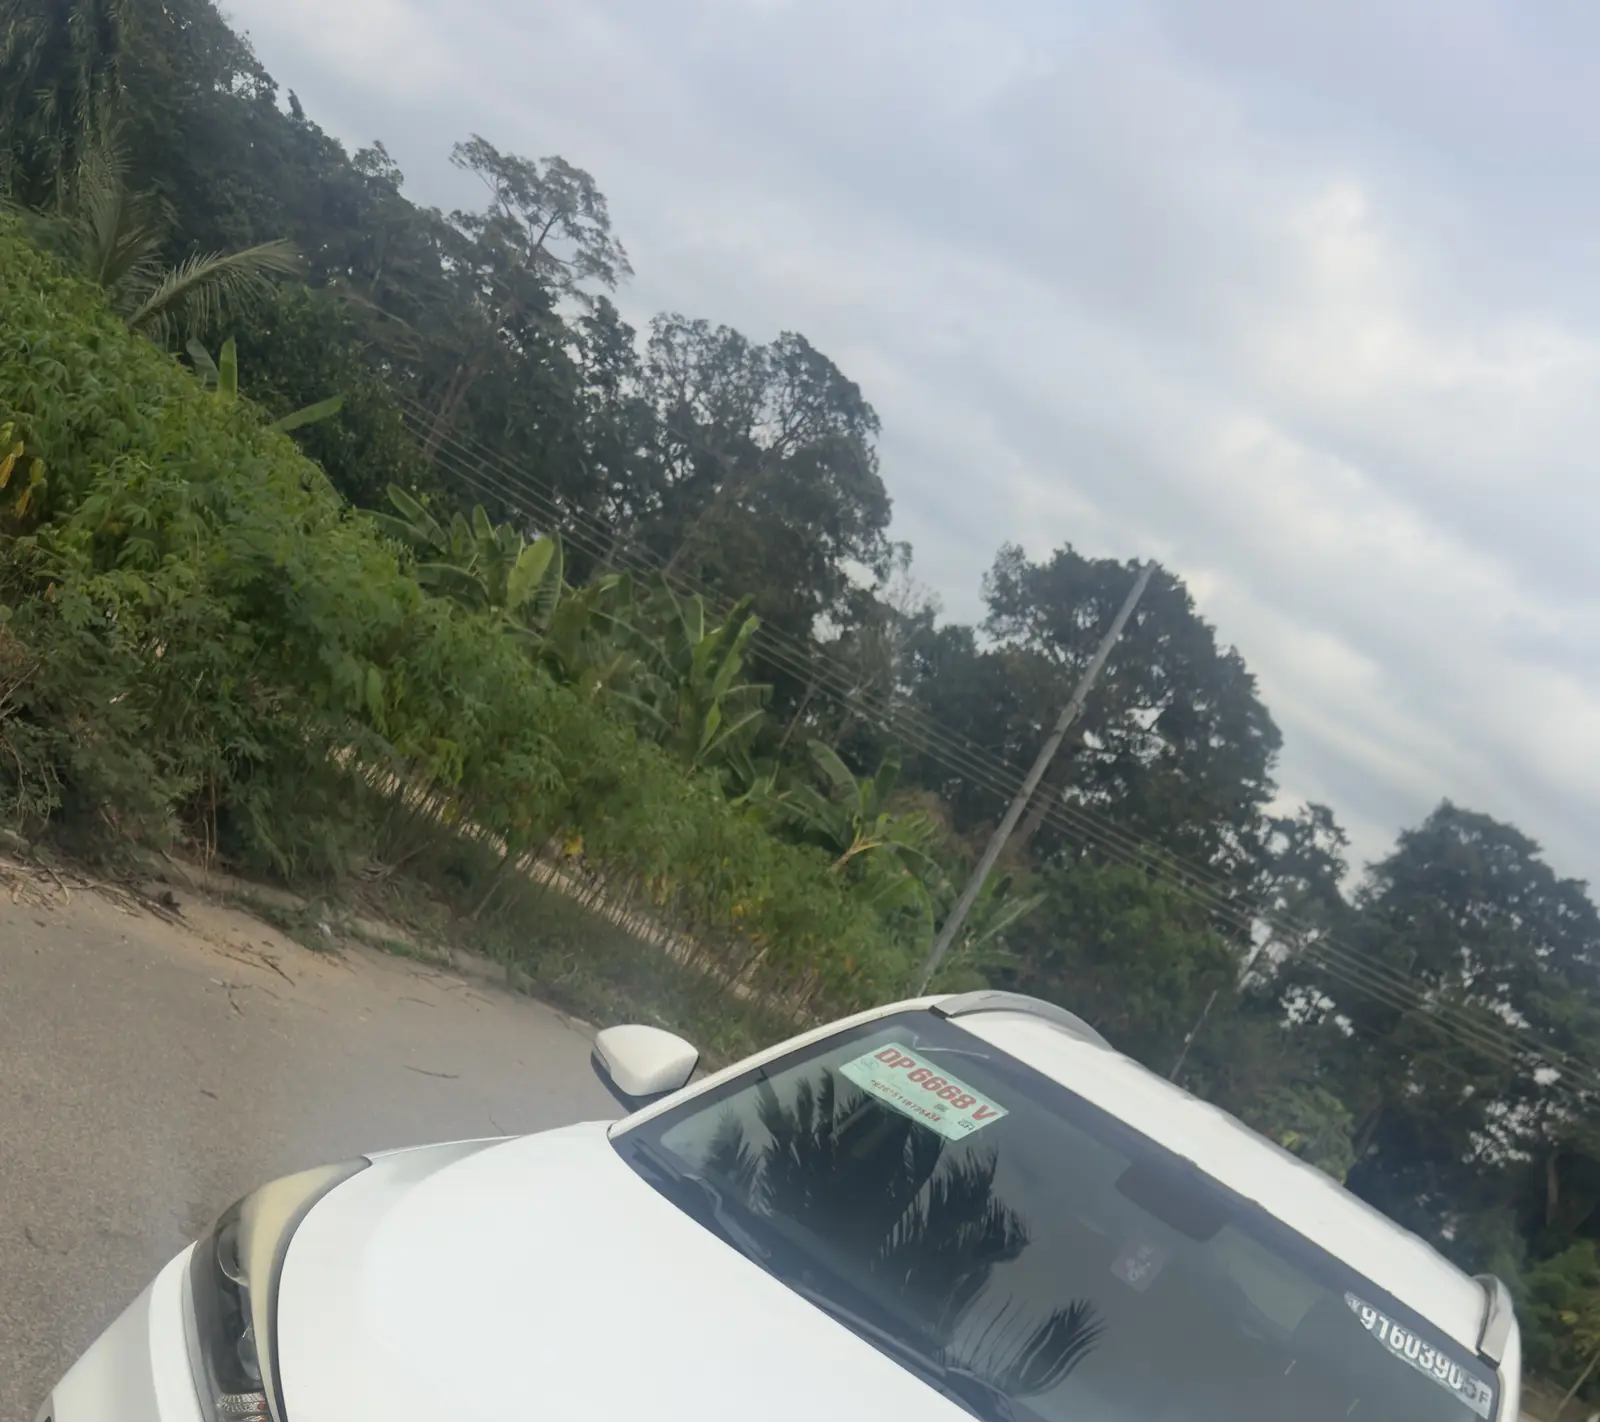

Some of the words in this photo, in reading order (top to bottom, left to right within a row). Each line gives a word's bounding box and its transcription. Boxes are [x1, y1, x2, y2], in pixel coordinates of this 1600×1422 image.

[874, 1048, 916, 1069] DP
[907, 1068, 976, 1110] 6668
[971, 1105, 998, 1121] V
